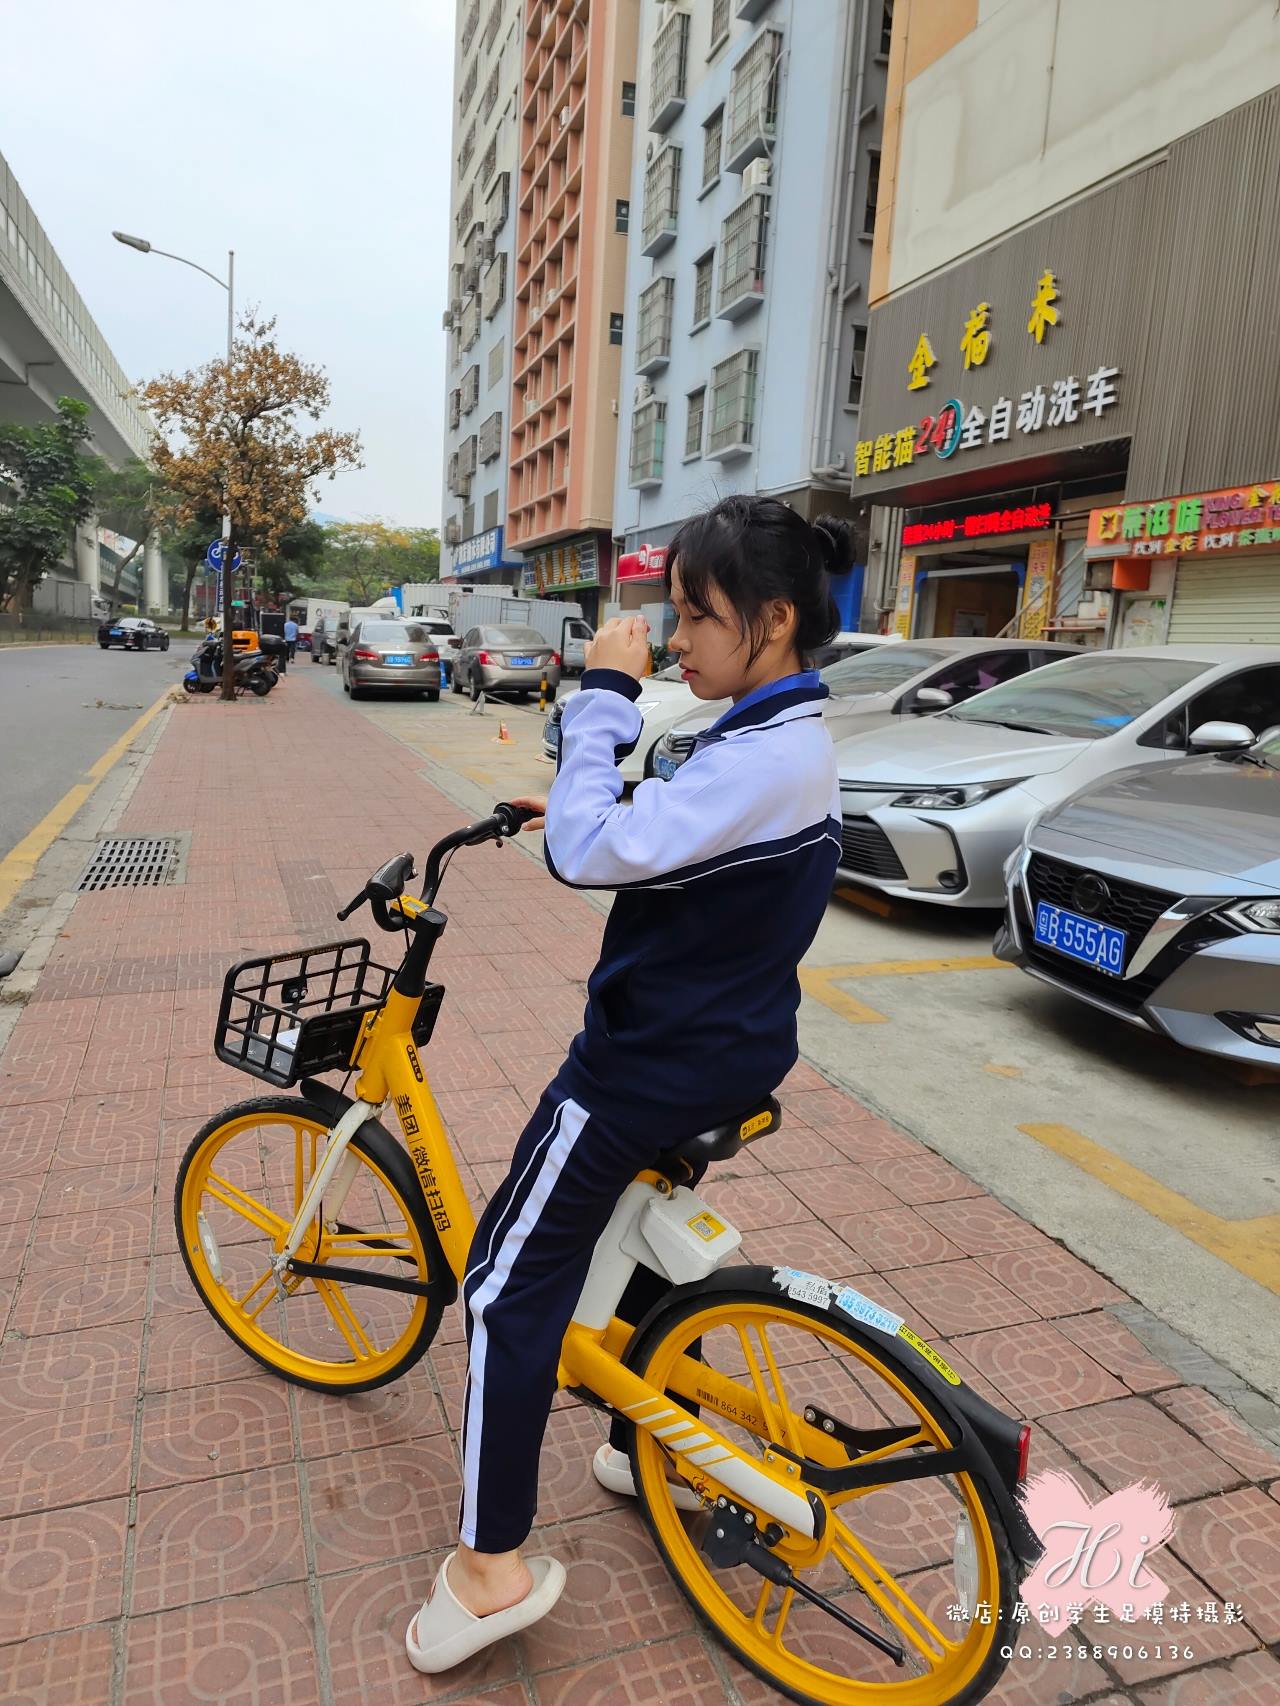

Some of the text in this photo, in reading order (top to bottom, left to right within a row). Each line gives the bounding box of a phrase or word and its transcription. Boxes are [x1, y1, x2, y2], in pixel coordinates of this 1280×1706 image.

[395, 1094, 451, 1232] 美团 微信扫码
[721, 1401, 757, 1426] 864 342
